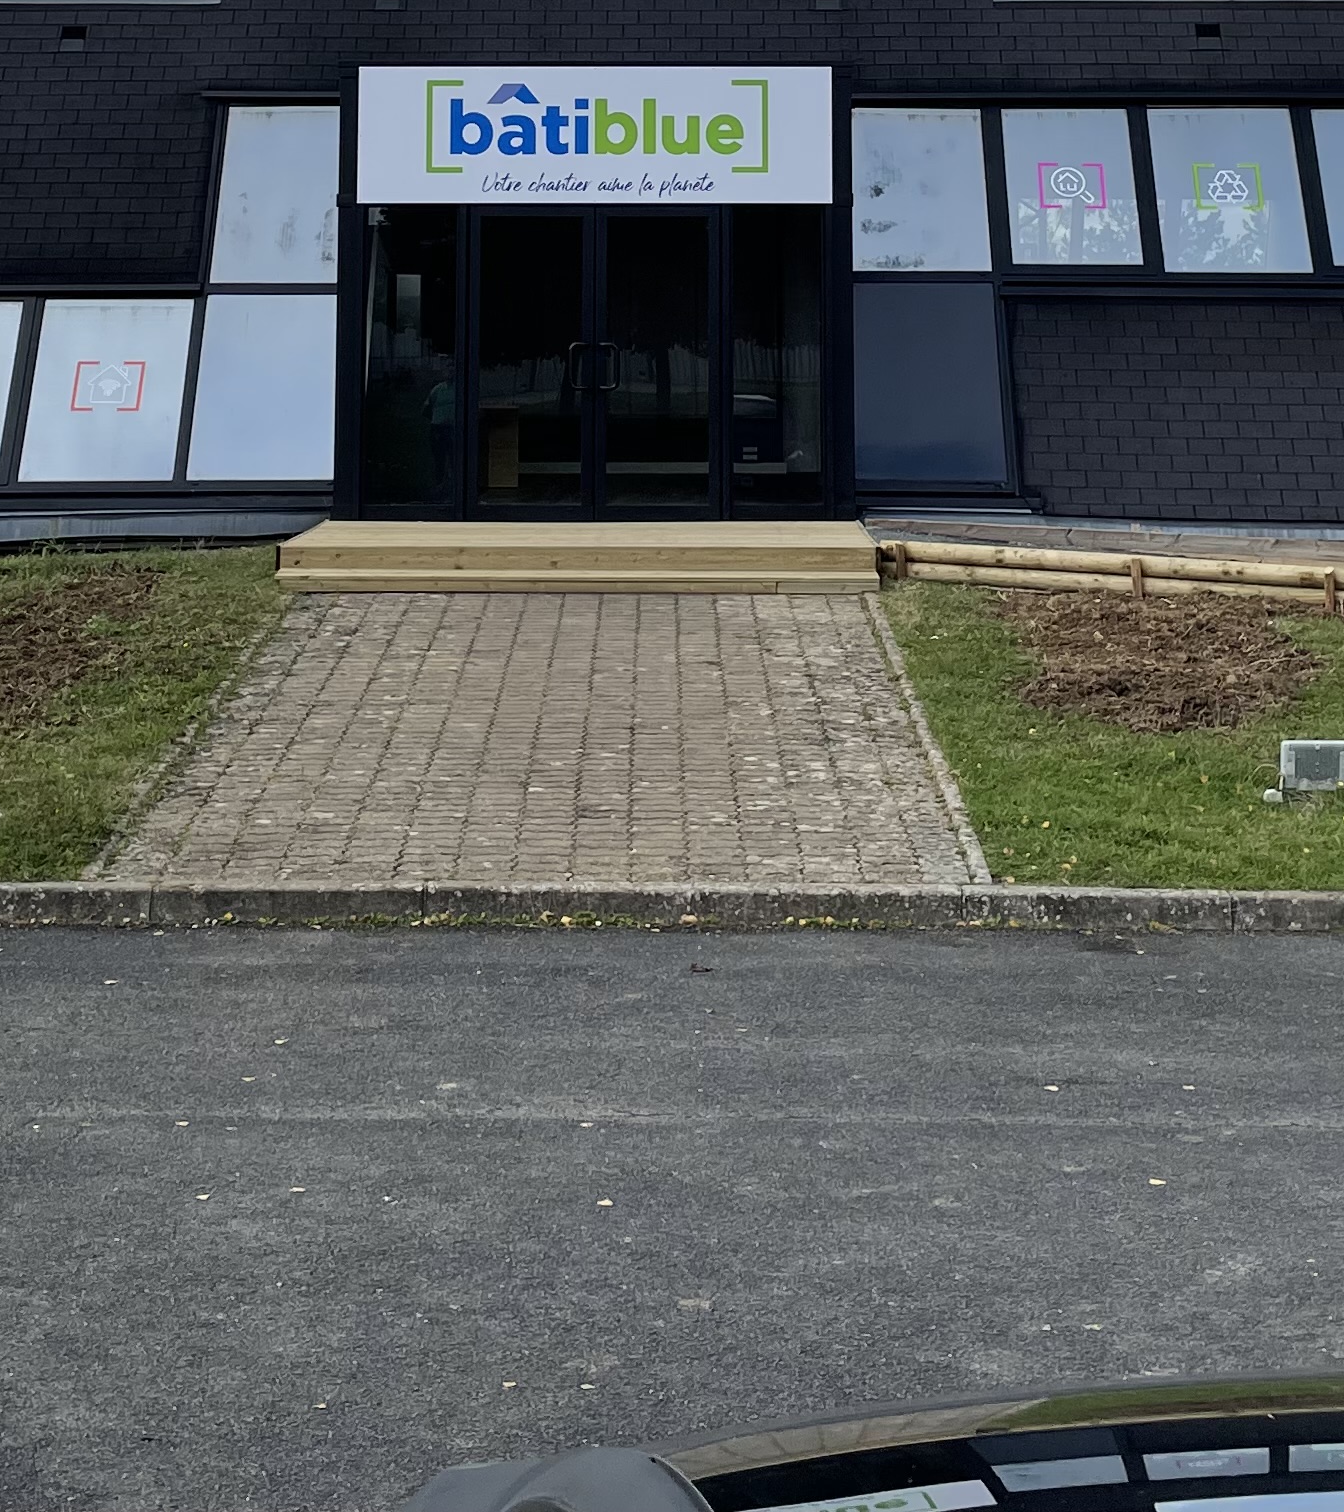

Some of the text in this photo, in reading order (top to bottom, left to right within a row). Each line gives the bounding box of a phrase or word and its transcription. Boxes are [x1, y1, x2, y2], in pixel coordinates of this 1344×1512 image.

[450, 83, 744, 155] bâtiblue
[481, 171, 523, 192] Votre
[527, 172, 592, 192] chantier
[597, 177, 633, 191] aime
[638, 172, 655, 196] la
